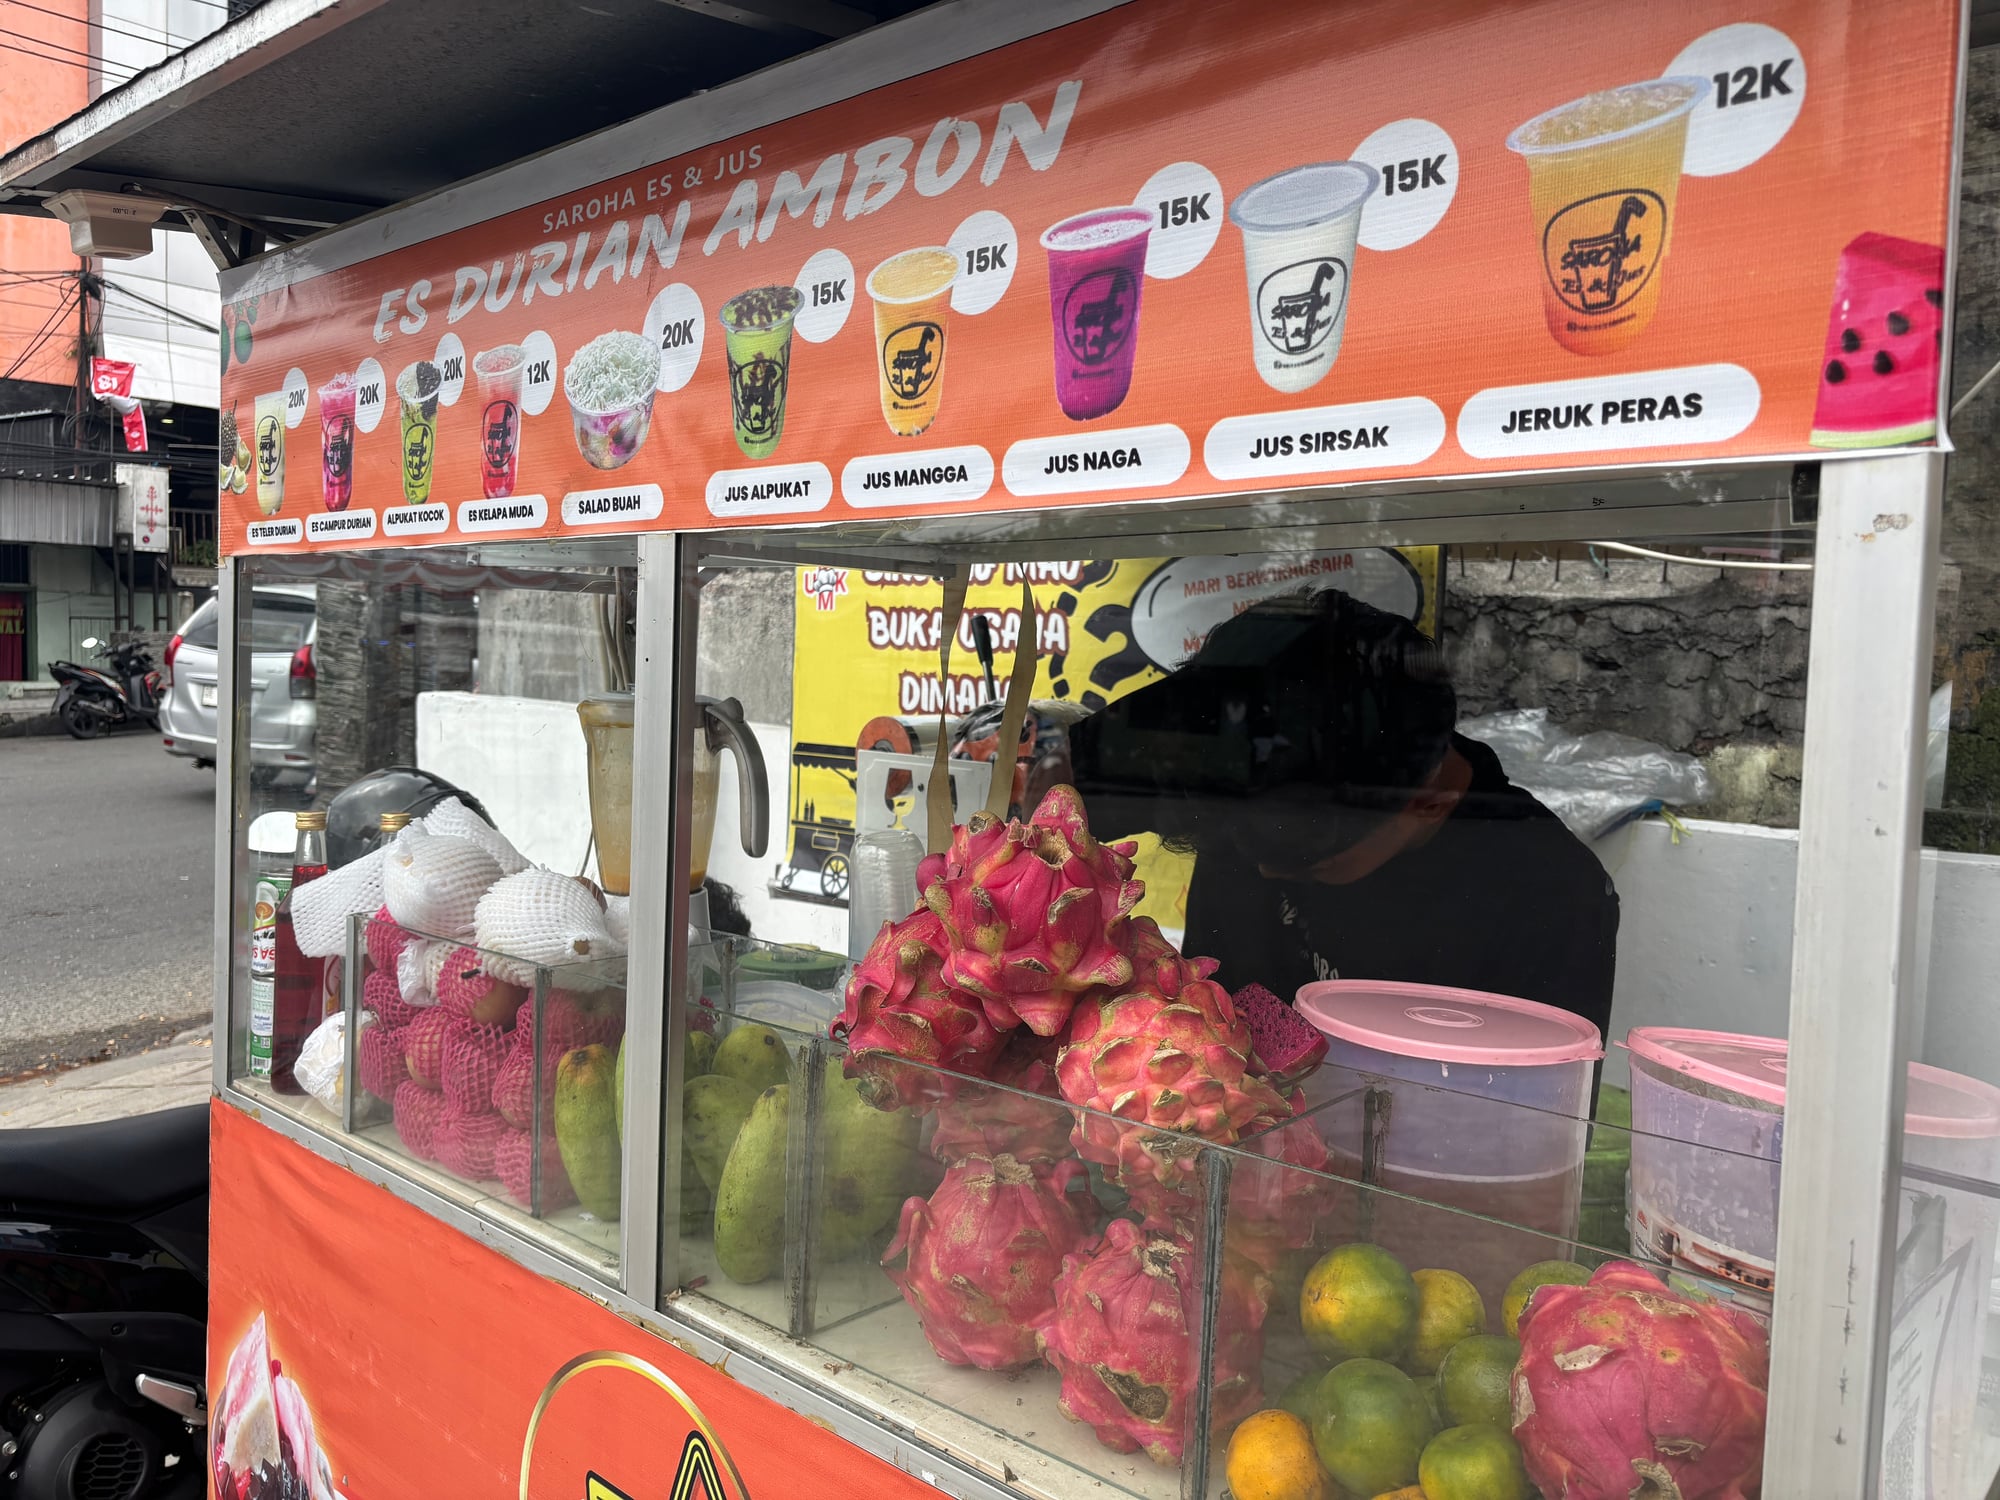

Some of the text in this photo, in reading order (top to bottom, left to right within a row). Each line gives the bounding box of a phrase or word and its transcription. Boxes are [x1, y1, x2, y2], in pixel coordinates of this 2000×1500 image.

[1713, 58, 1793, 108] 12K
[1382, 153, 1447, 196] 15K
[543, 144, 762, 233] SAROHA ES & JUS
[373, 80, 1082, 343] ES DURIAN AMBON
[1159, 192, 1211, 229] 15K
[966, 243, 1008, 275] 15K
[812, 278, 847, 307] 15K
[662, 318, 695, 350] 20K
[444, 356, 463, 382] 20K
[527, 359, 550, 385] 12K
[288, 388, 306, 409] 20K
[359, 383, 379, 405] 20K
[1501, 392, 1703, 434] JERUK PERAS
[1249, 425, 1389, 459] JUS SIRSAK
[1044, 447, 1142, 475] JUS NAGA
[863, 464, 968, 490] JUS MANGGA
[725, 480, 811, 502] JUS ALPUKAT
[387, 509, 444, 525] ALPUKAT KOCOK
[468, 504, 534, 522] ES KELAPA MUDA
[579, 495, 641, 515] SALAD BUAH
[252, 525, 296, 538] ES TELER DURIAN
[311, 517, 372, 533] ES CAMPUR DURIAN
[1184, 577, 1220, 599] MARI
[869, 609, 943, 647] BUKA
